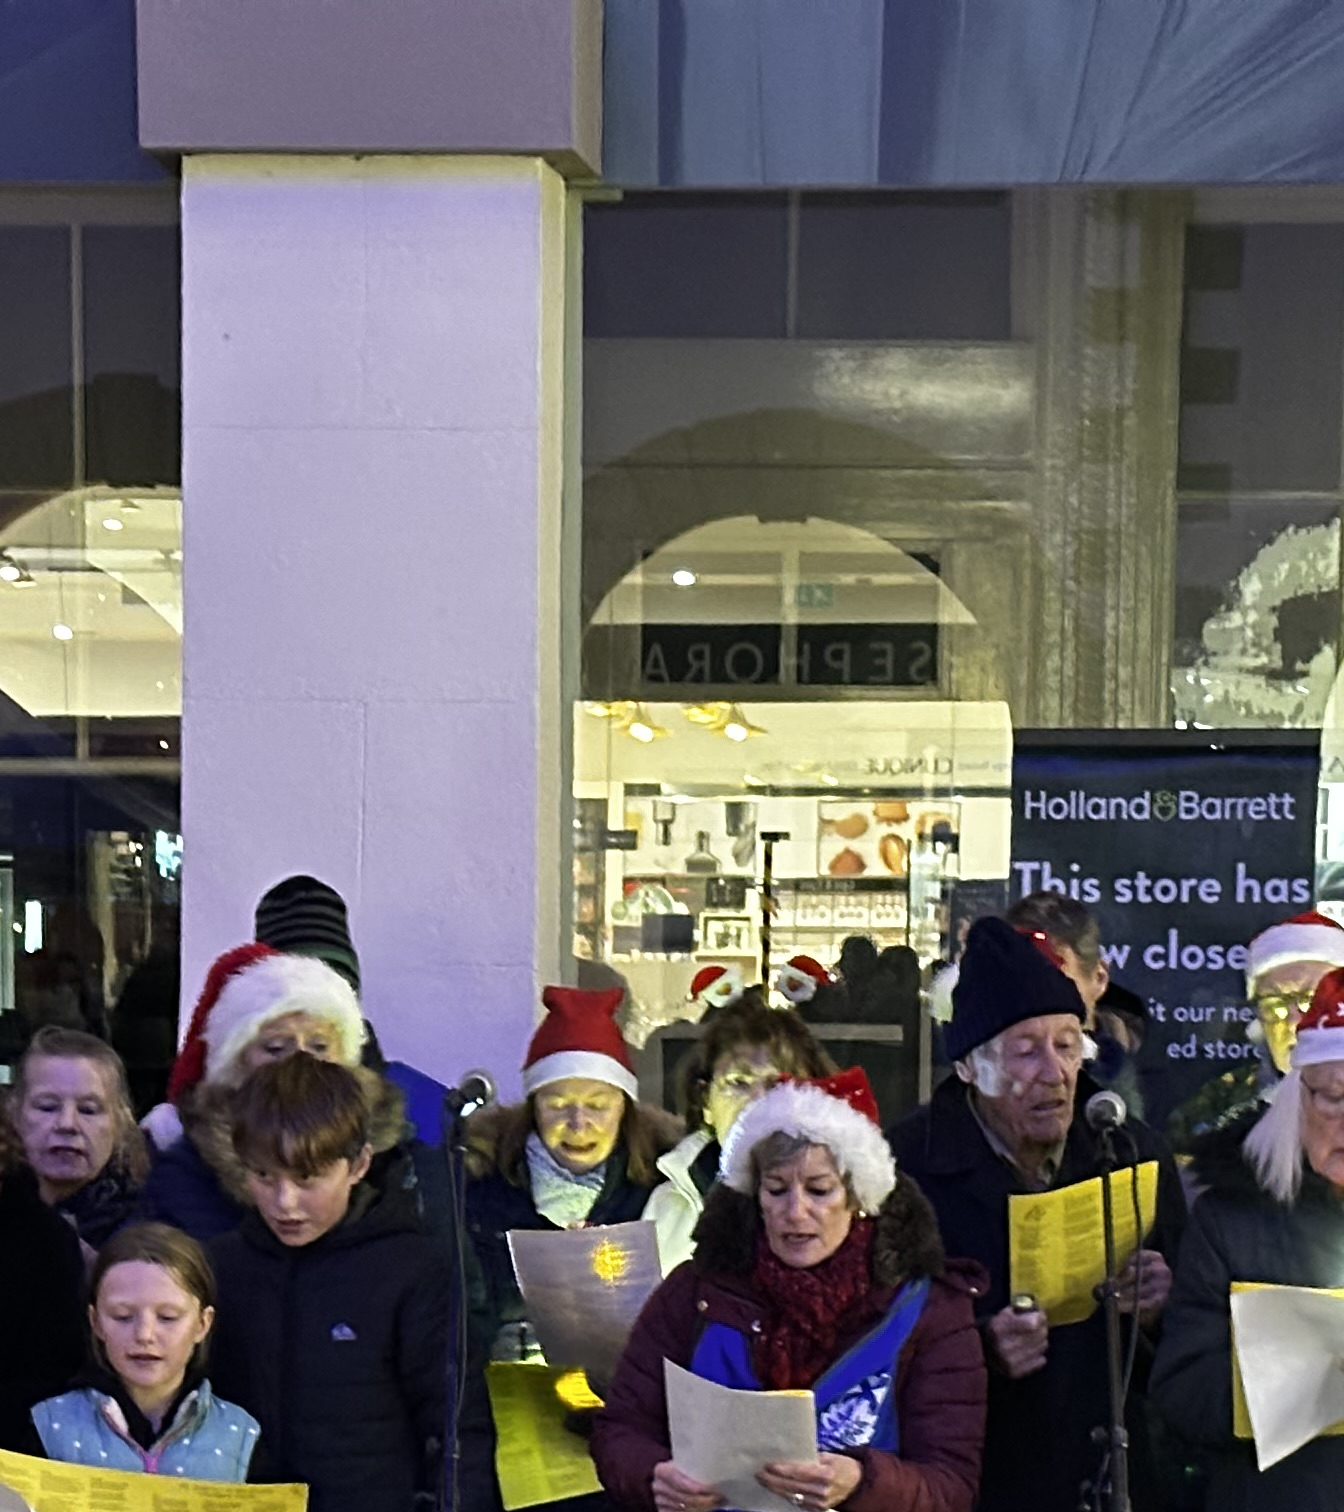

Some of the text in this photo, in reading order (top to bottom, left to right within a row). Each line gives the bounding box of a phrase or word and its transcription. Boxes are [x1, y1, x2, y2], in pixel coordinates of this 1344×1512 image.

[1024, 790, 1151, 820] Holland
[1178, 790, 1296, 820] Barrett
[1013, 861, 1311, 904] This store has
[1142, 927, 1250, 970] close
[1172, 1005, 1217, 1023] our
[1222, 1005, 1254, 1023] ne
